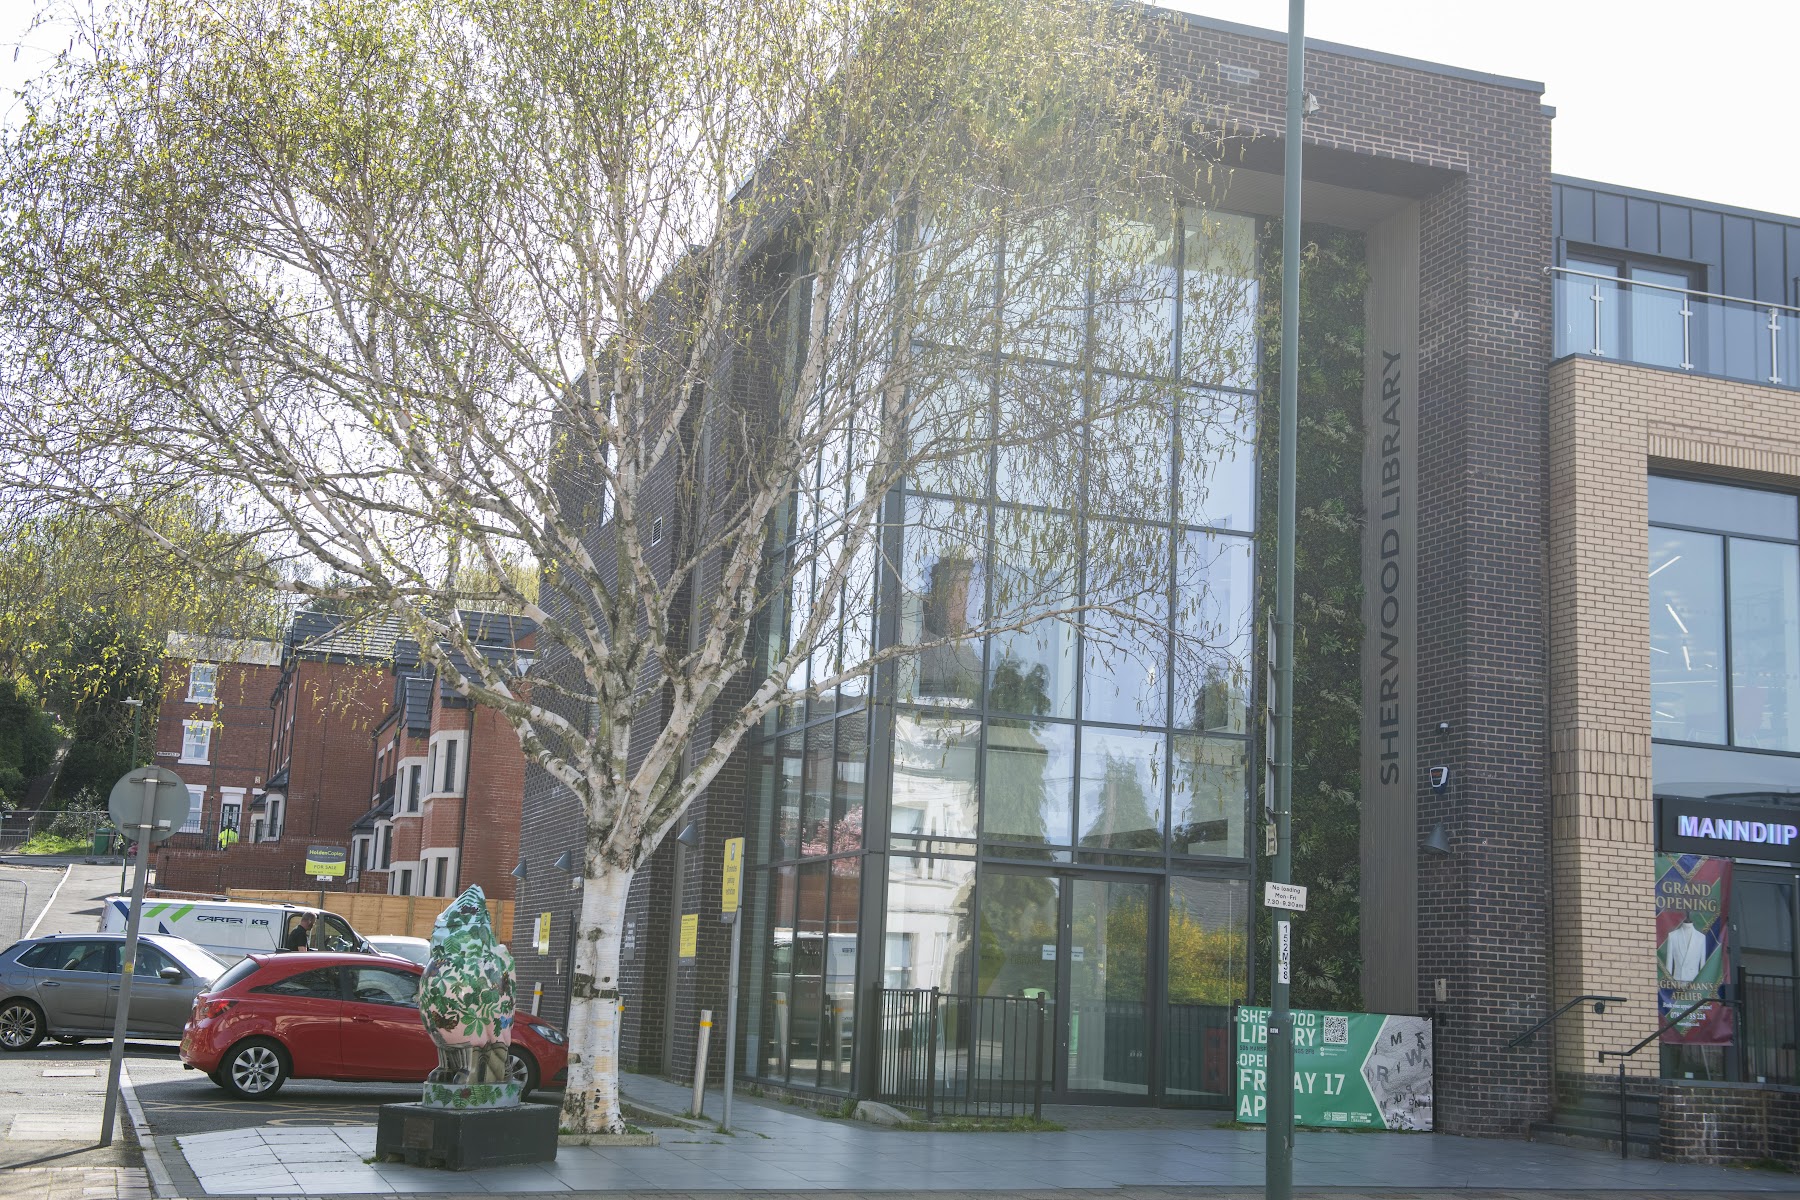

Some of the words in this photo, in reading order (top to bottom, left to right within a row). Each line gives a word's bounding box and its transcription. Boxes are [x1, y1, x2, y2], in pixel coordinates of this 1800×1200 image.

[1381, 348, 1400, 519] LIBRARY
[1380, 528, 1400, 786] SHERWOOD
[1677, 815, 1798, 846] MANNDIIP
[1281, 886, 1301, 894] loading
[1662, 881, 1711, 897] GRAND
[1655, 895, 1717, 912] OPENING
[197, 915, 243, 924] CARTER
[1672, 992, 1703, 1001] ATELIER
[1240, 1009, 1316, 1027] SHEOOD
[1240, 1024, 1317, 1047] LIBRY
[1240, 1069, 1317, 1094] FRAY
[1324, 1073, 1346, 1095] 17
